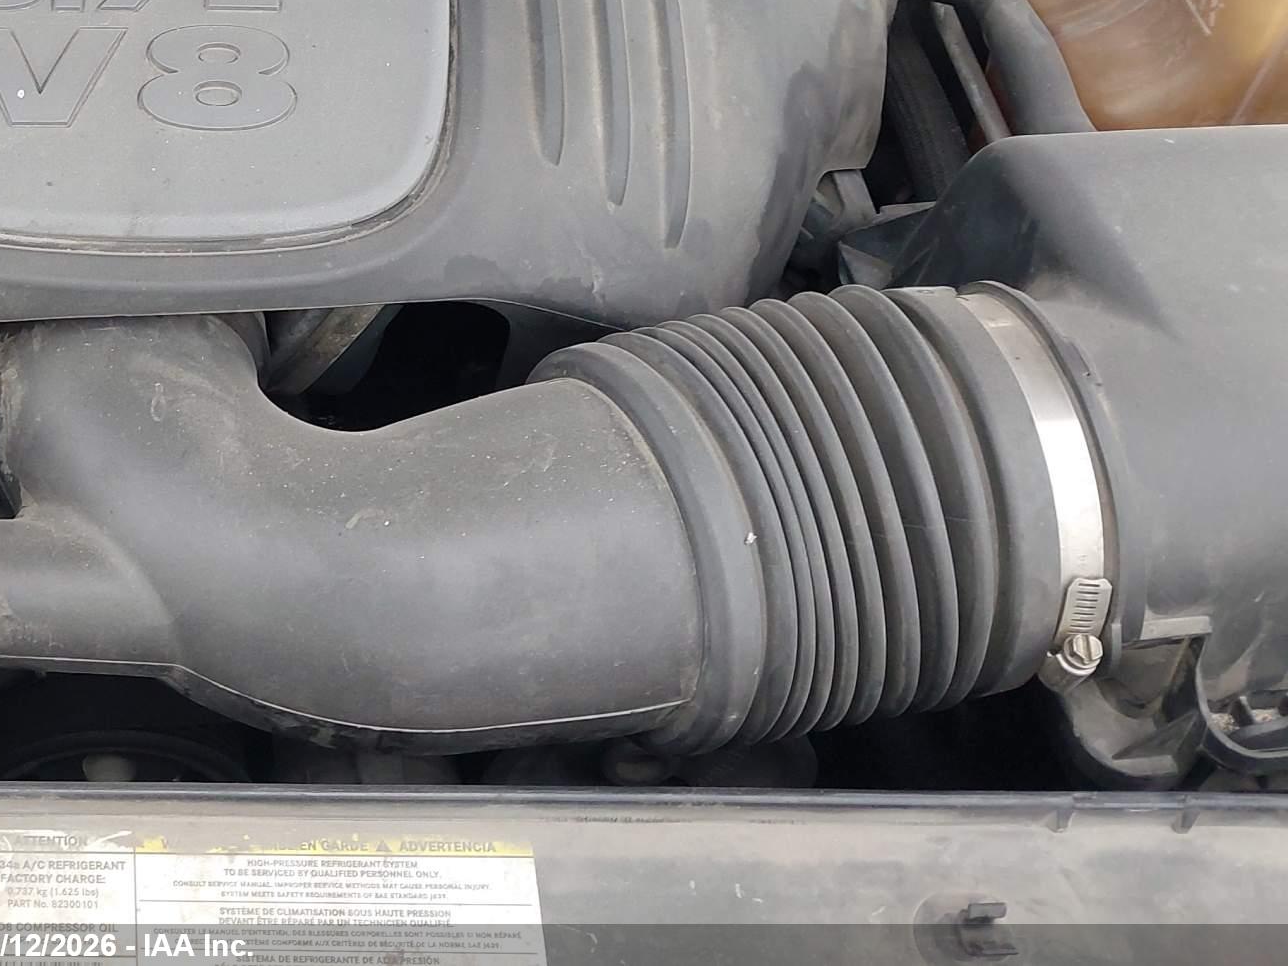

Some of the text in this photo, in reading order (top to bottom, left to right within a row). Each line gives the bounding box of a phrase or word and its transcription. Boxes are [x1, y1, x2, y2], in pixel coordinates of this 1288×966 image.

[321, 840, 369, 852] GARDE
[399, 841, 497, 853] ADVERTENCIA
[22, 860, 45, 870] A/C
[47, 860, 127, 871] REFRIGERANT
[247, 859, 418, 869] HIGH-PRESSURE REFRIGERANT SYSTEM
[0, 874, 106, 884] FACTORY CHARGE:
[224, 868, 442, 879] TO BE SERVICED BY QUALIFIED PERSONNEL ONLY.
[7, 887, 100, 898] 0.737 kg (1.625 lbs)
[7, 899, 99, 909] PART No. 82300101
[262, 907, 275, 916] DE
[276, 907, 346, 917] CLIMATISATION
[348, 909, 372, 917] SOUS
[374, 909, 405, 917] HAUTE
[406, 909, 452, 918] PRESSION
[15, 922, 96, 933] COMPRESSOR
[98, 923, 118, 933] OIL
[219, 917, 256, 925] DEVANT
[317, 919, 335, 927] PAR
[337, 919, 350, 927] UN
[353, 919, 408, 928] TECHNICIEN
[209, 928, 240, 936] MANUEL
[236, 954, 277, 963] SISTEMA
[278, 955, 291, 963] DE
[293, 955, 361, 964] REFRIGERANTE
[363, 956, 374, 964] DE
